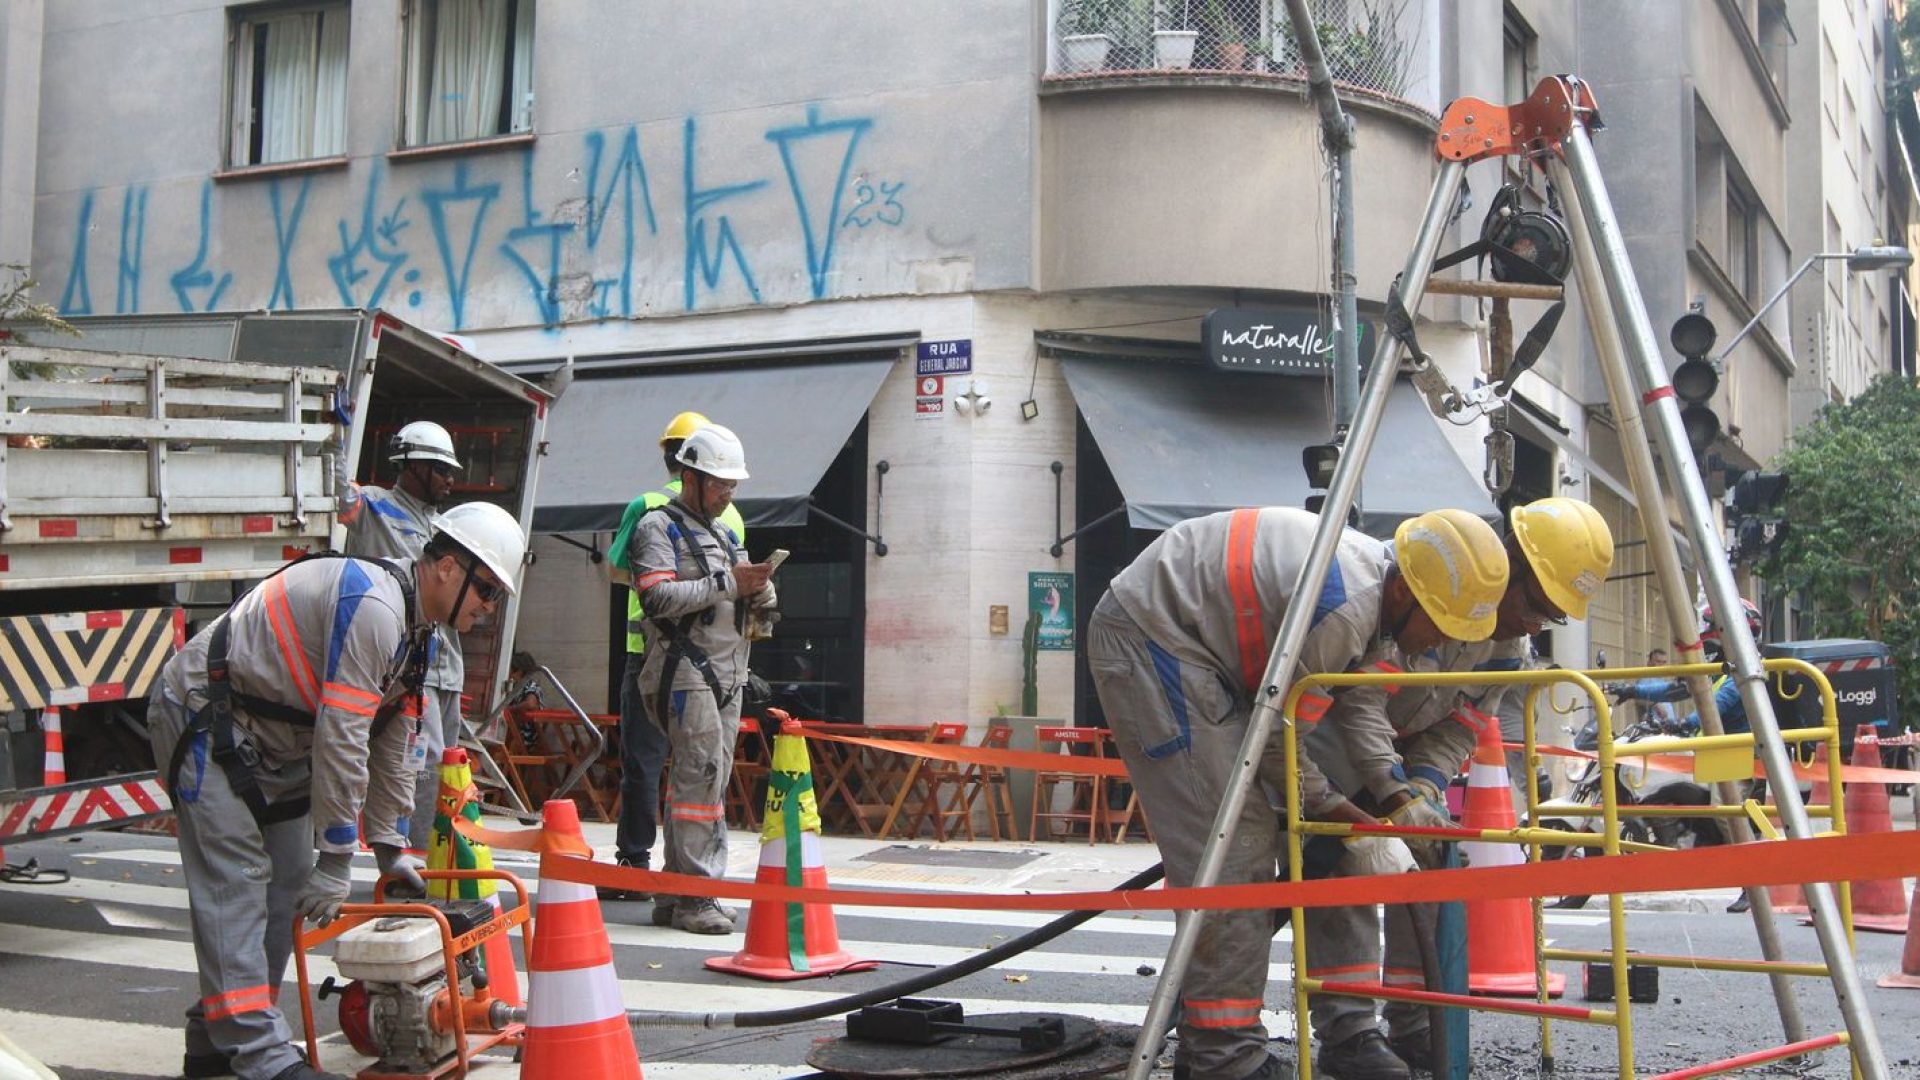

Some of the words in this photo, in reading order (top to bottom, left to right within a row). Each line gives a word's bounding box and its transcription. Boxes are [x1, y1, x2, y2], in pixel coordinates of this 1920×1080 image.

[929, 343, 957, 356] RUA
[1222, 354, 1245, 363] bar
[1839, 687, 1877, 706] Loggi
[1054, 731, 1080, 739] AMSTEL
